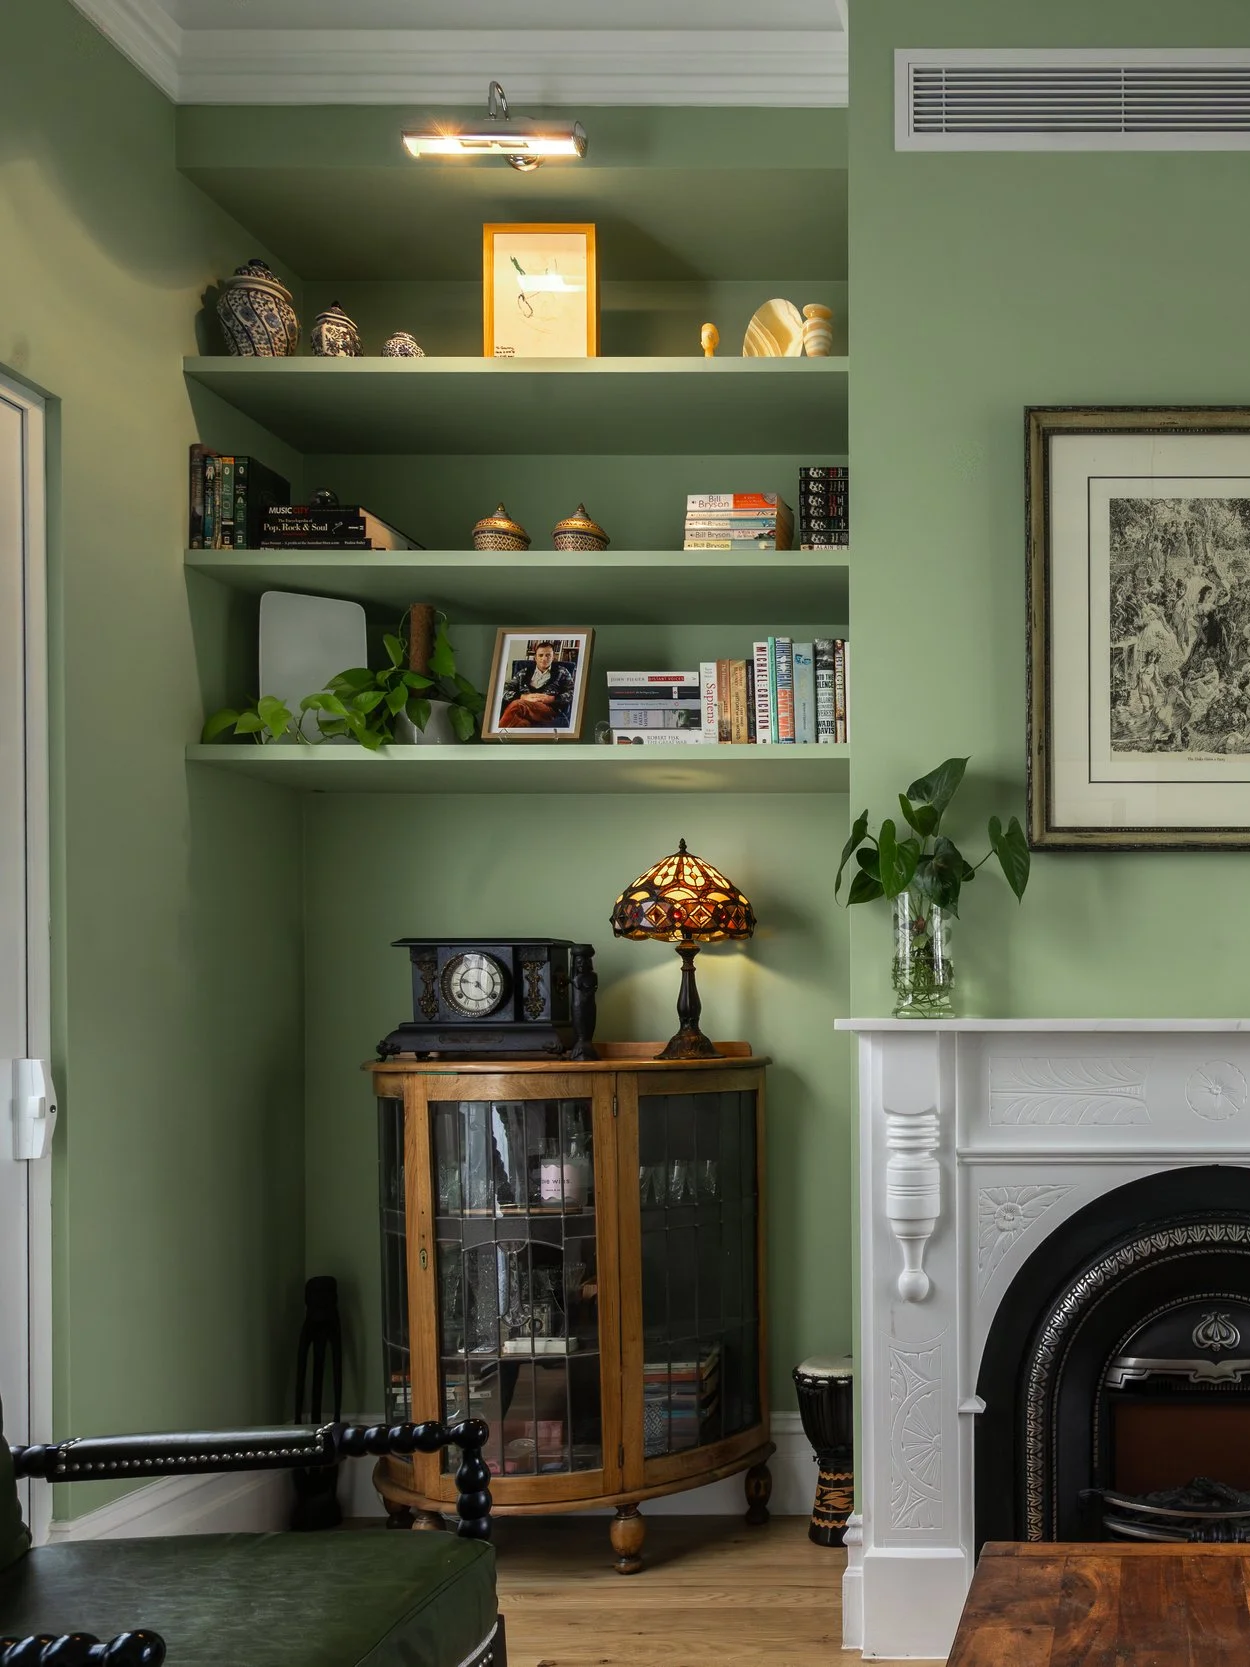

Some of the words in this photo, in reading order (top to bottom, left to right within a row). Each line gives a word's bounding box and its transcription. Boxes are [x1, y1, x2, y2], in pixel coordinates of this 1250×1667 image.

[698, 501, 730, 509] Bryson
[282, 523, 301, 531] Rock
[302, 523, 309, 531] &
[312, 523, 328, 531] Soul
[756, 646, 767, 683] MICHAEL
[704, 683, 717, 724] Sapiens
[758, 688, 769, 730] CRICHTON
[778, 690, 789, 715] CIVIL
[778, 716, 790, 737] WAR
